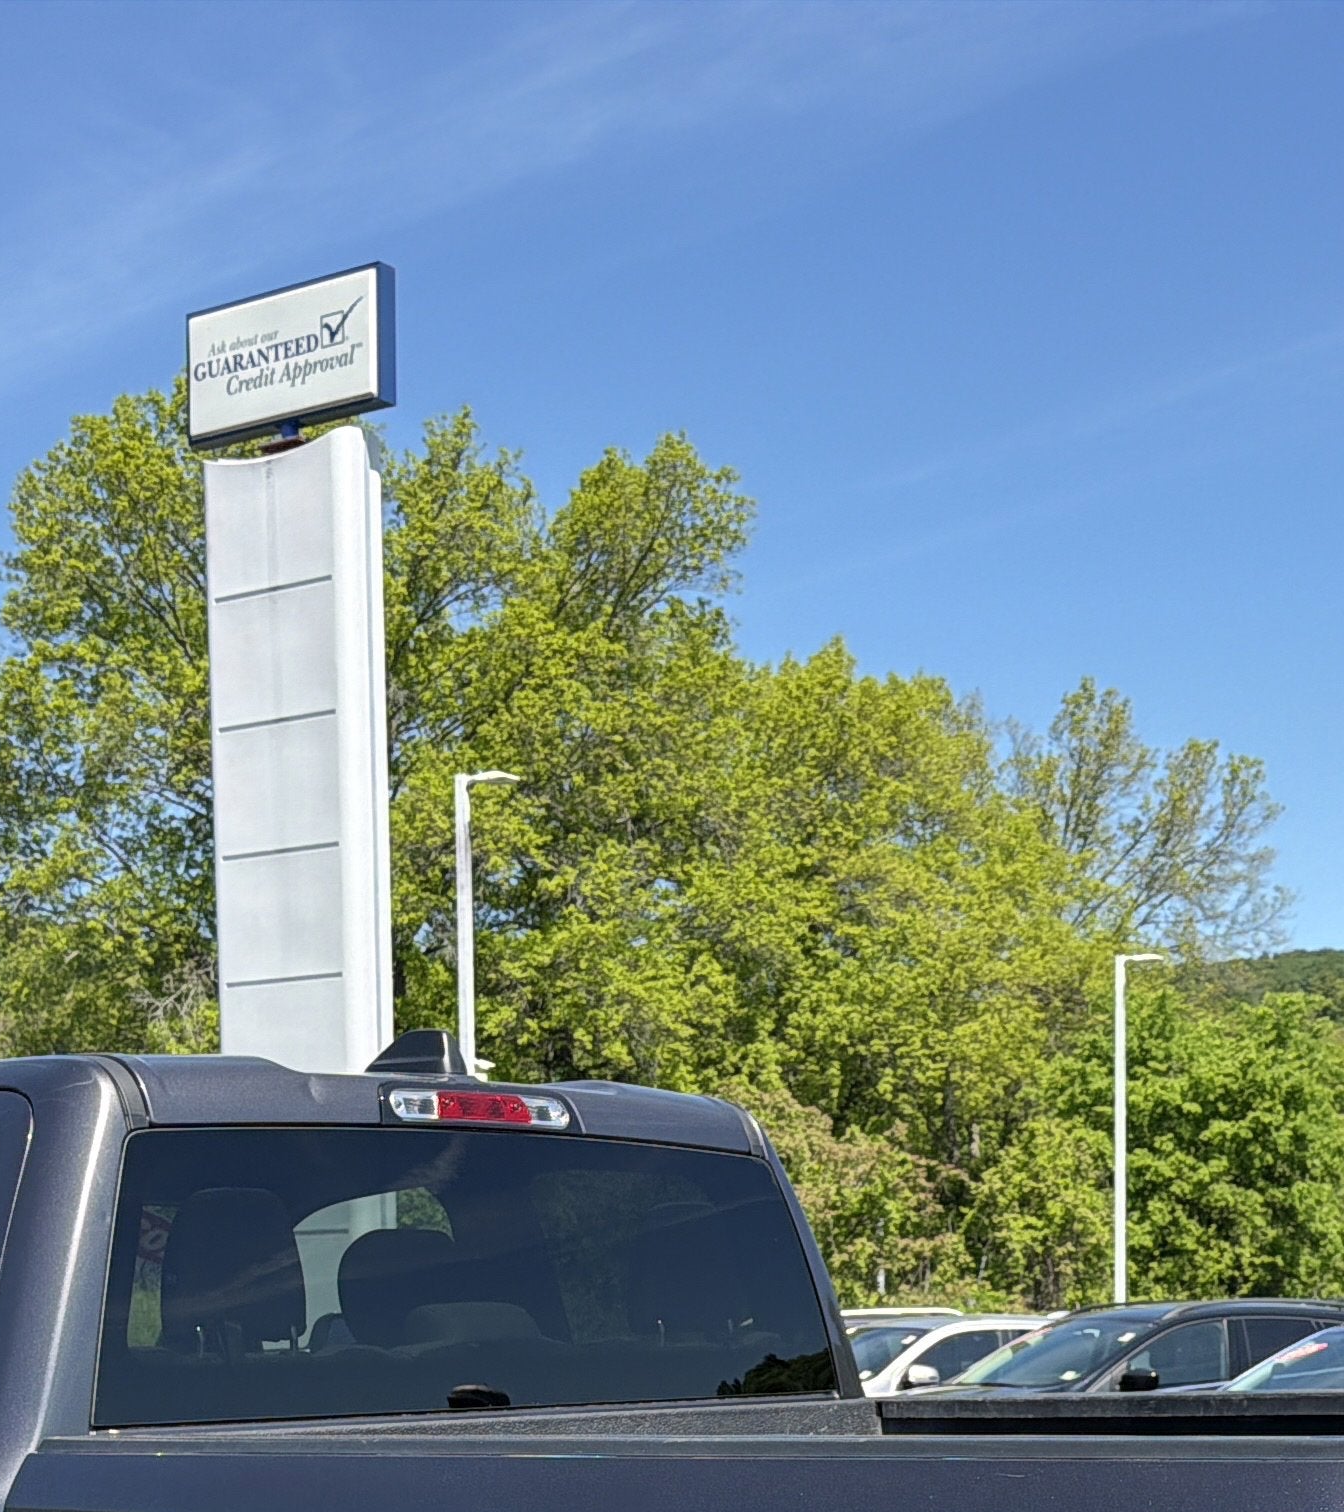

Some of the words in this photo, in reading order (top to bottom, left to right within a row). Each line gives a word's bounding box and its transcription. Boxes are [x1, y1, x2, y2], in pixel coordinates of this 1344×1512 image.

[193, 333, 319, 382] GUARANTEED
[207, 340, 227, 357] Ask
[229, 334, 258, 353] about
[260, 329, 279, 342] our
[226, 367, 276, 396] Credit
[279, 343, 356, 388] Approval
